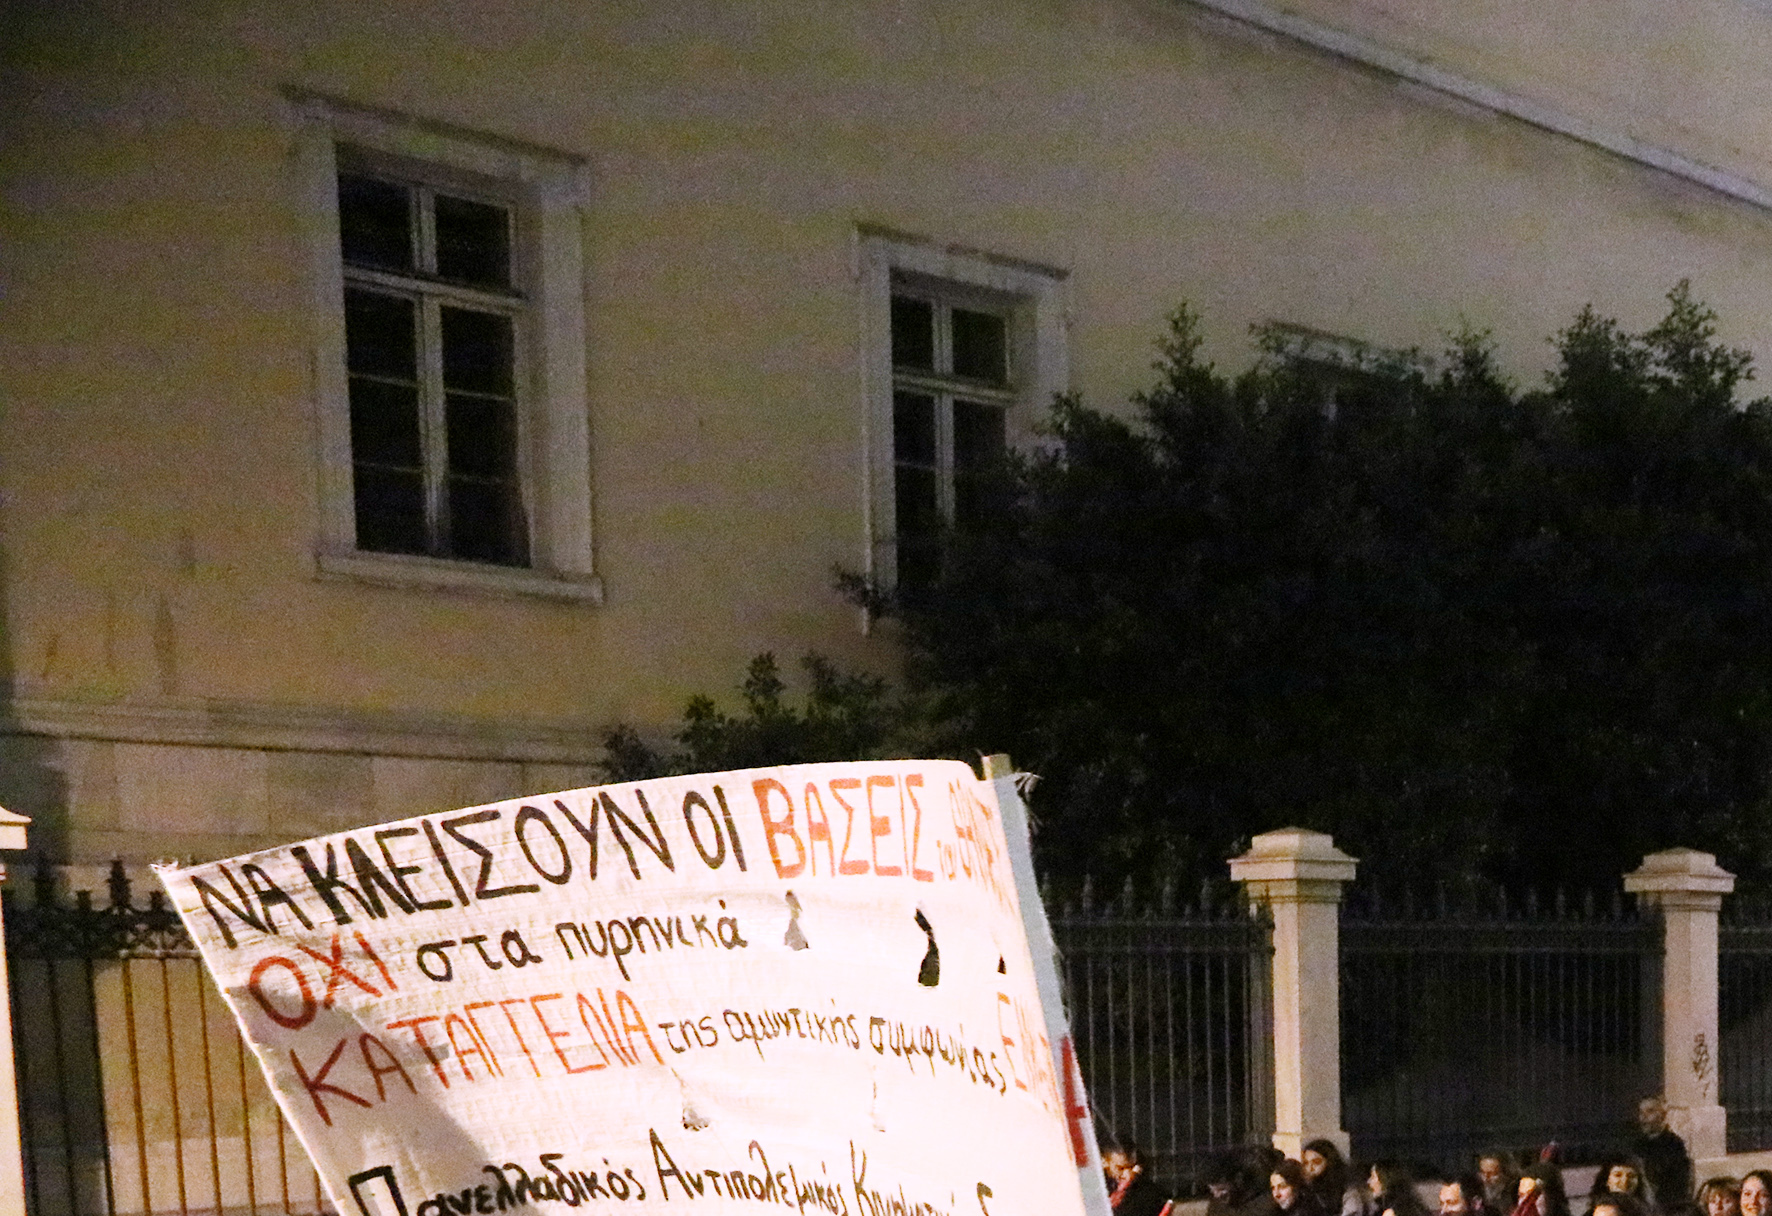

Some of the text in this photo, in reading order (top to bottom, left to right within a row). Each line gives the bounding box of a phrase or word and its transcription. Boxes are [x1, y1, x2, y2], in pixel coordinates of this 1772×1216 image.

[191, 862, 313, 949] ΝΑ
[291, 788, 675, 926] ΚΛΕΙΣΟΥΝ
[684, 782, 747, 873] ΟΙ
[751, 773, 935, 883] ΒΑΣΕΙΣ
[249, 900, 749, 1029] ΟΧΙ στα πυρηνικά
[658, 1011, 719, 1054] της
[869, 1015, 1007, 1096] συμφωνίας
